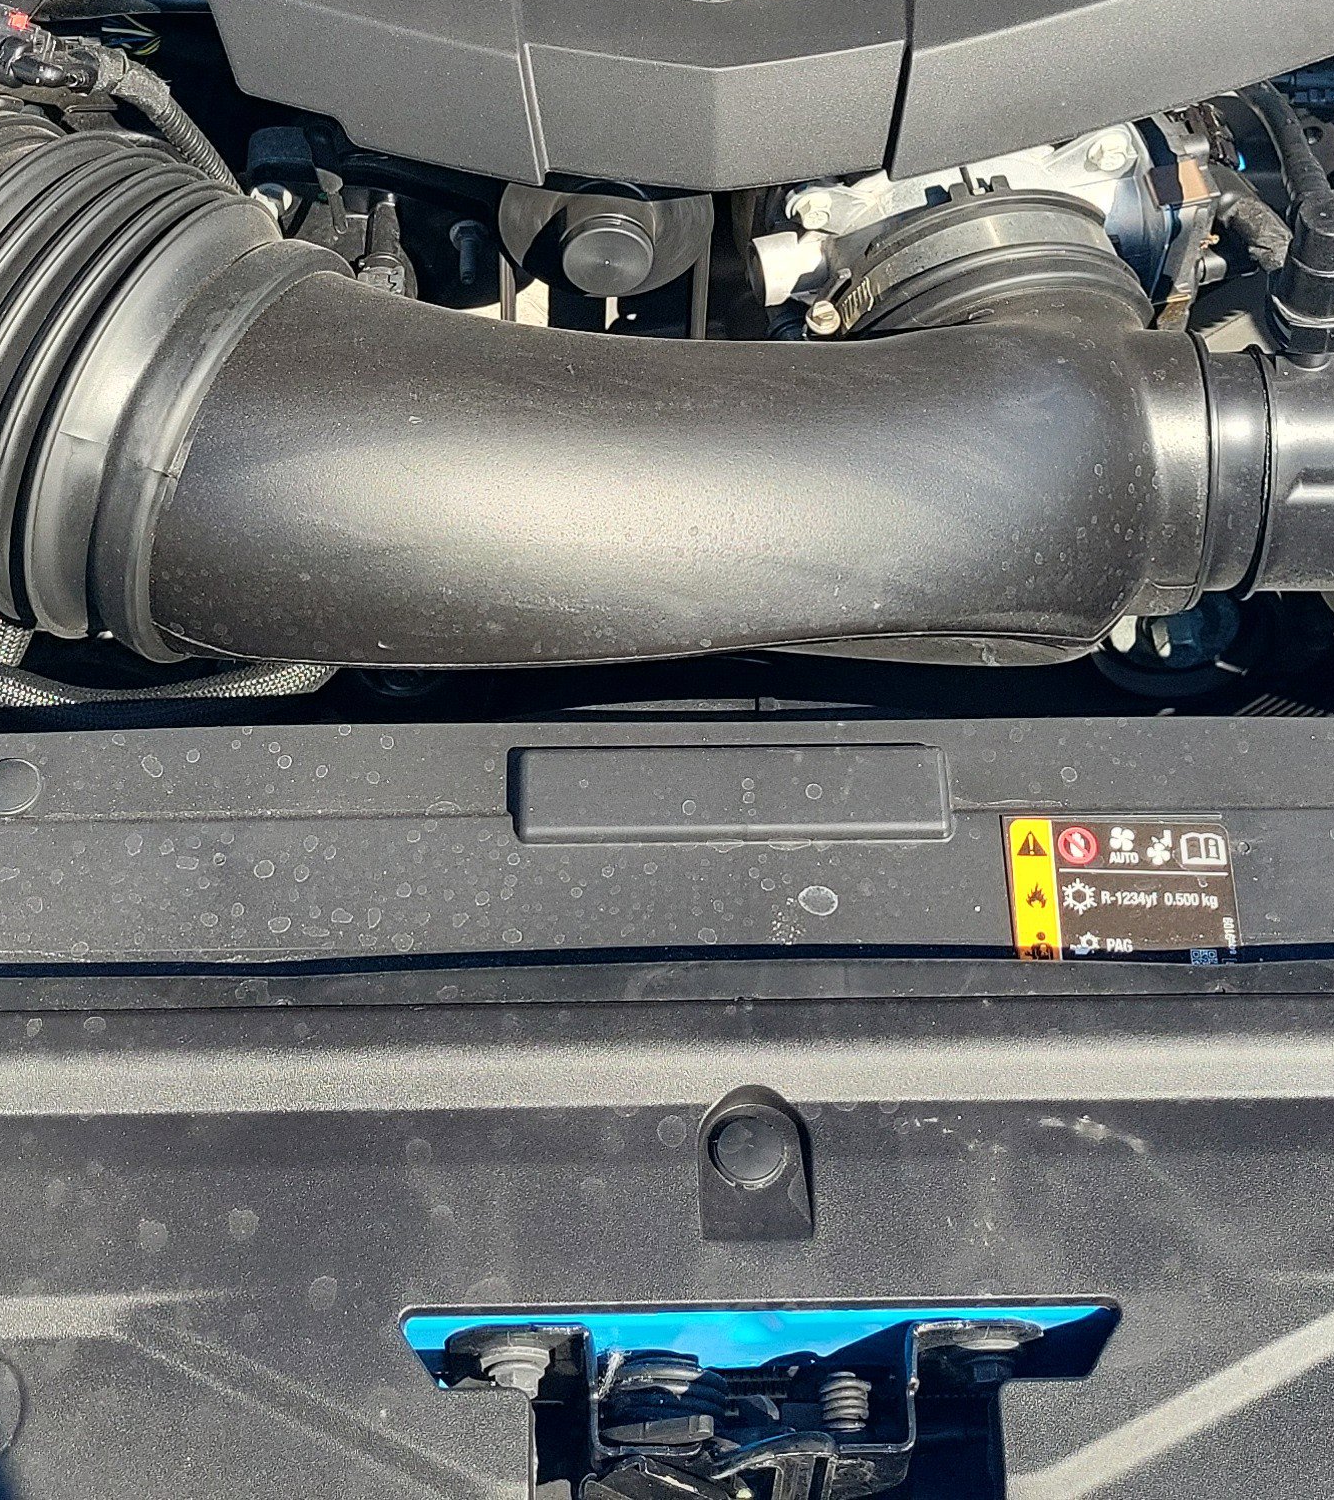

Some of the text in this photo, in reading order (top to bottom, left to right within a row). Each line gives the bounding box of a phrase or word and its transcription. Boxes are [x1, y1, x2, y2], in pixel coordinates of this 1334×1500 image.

[1109, 851, 1139, 864] AUTO
[1100, 890, 1219, 910] R-1234yf 0.500 kg
[1106, 937, 1133, 954] PAG
